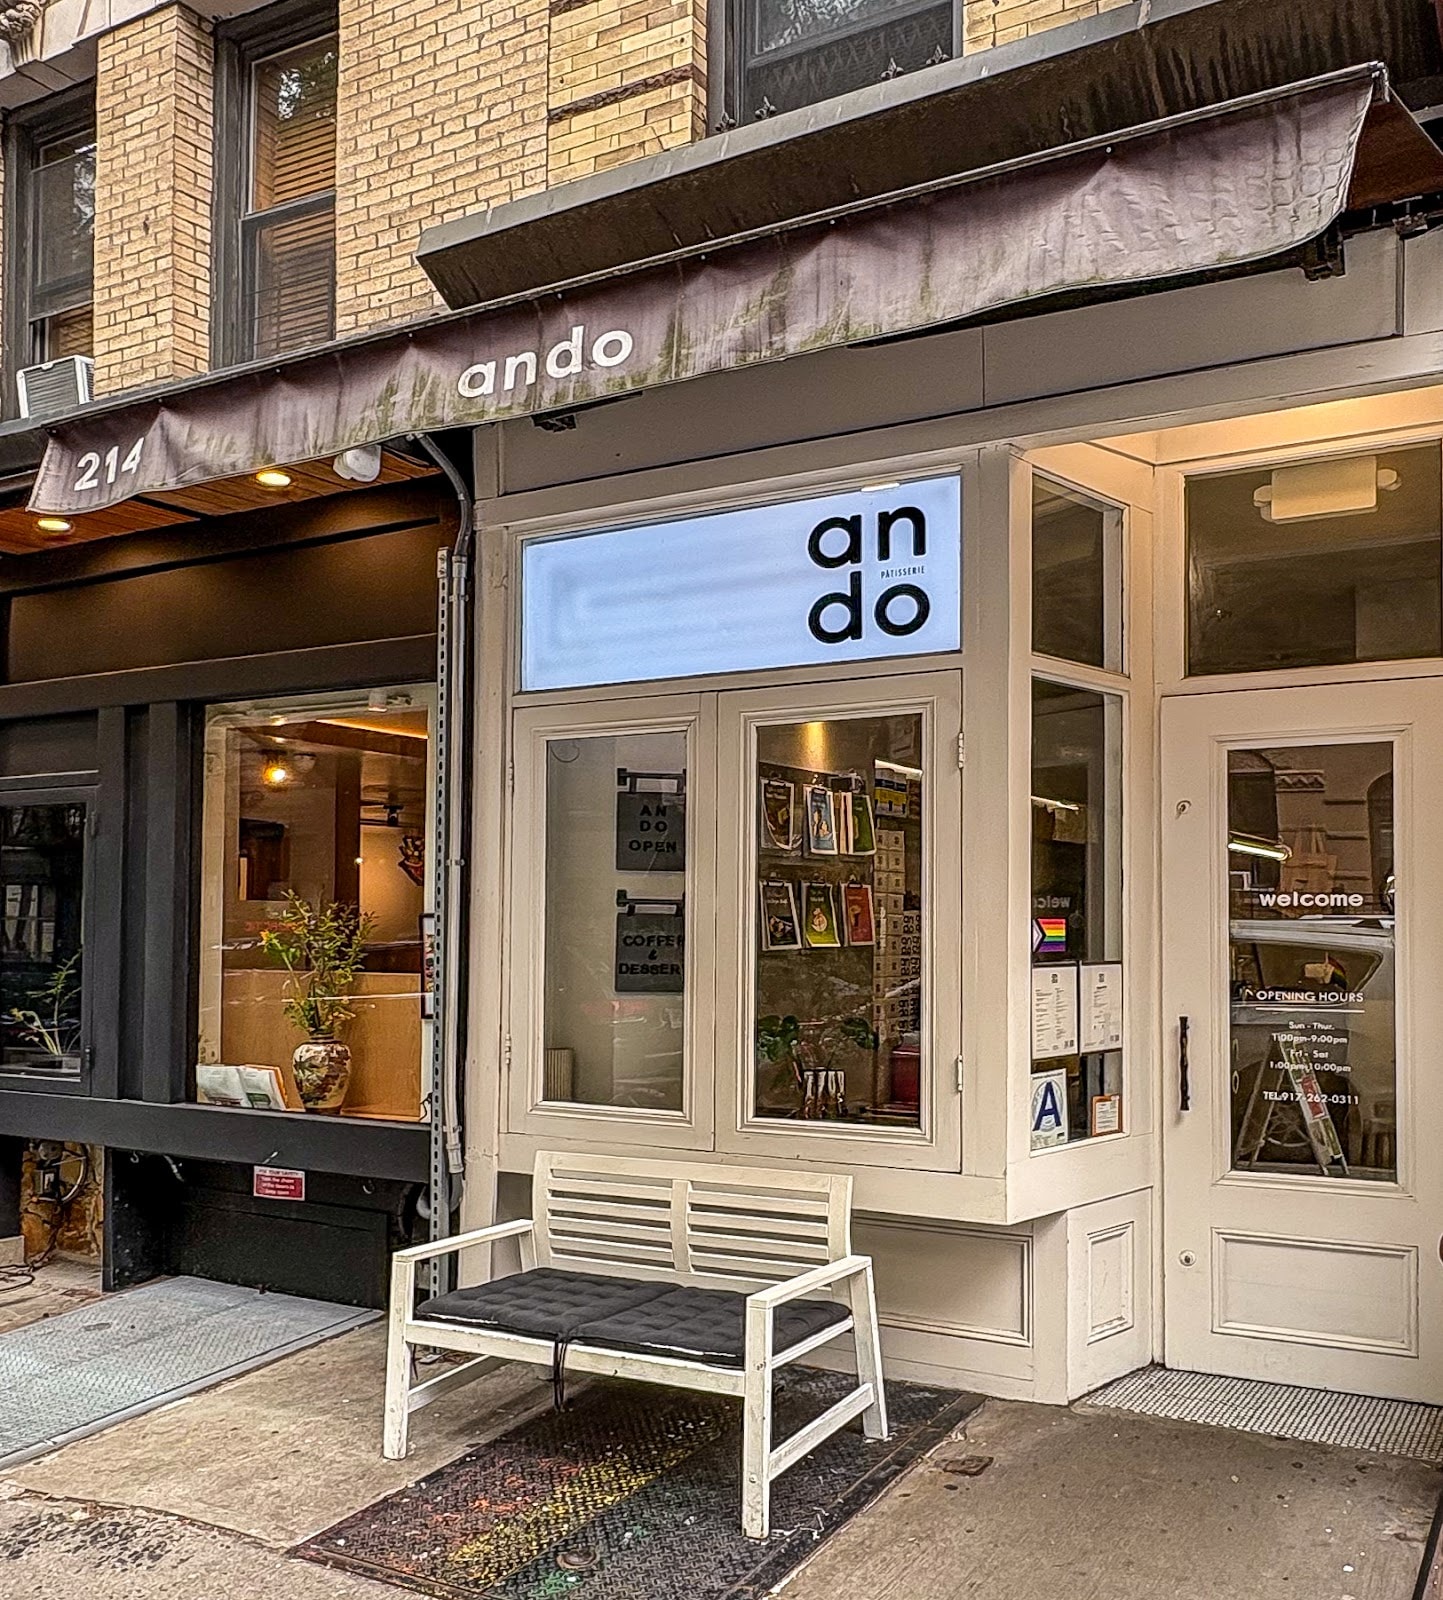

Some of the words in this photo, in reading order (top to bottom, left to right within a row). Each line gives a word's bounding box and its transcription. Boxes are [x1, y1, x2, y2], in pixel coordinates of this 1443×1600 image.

[457, 325, 633, 398] ando
[74, 436, 145, 491] 214
[628, 839, 677, 852] OPEN
[1259, 891, 1364, 907] welcome
[618, 963, 683, 975] DESSER
[1256, 990, 1316, 1001] OPENING
[1319, 991, 1364, 1003] HOURS
[1032, 1081, 1062, 1131] A
